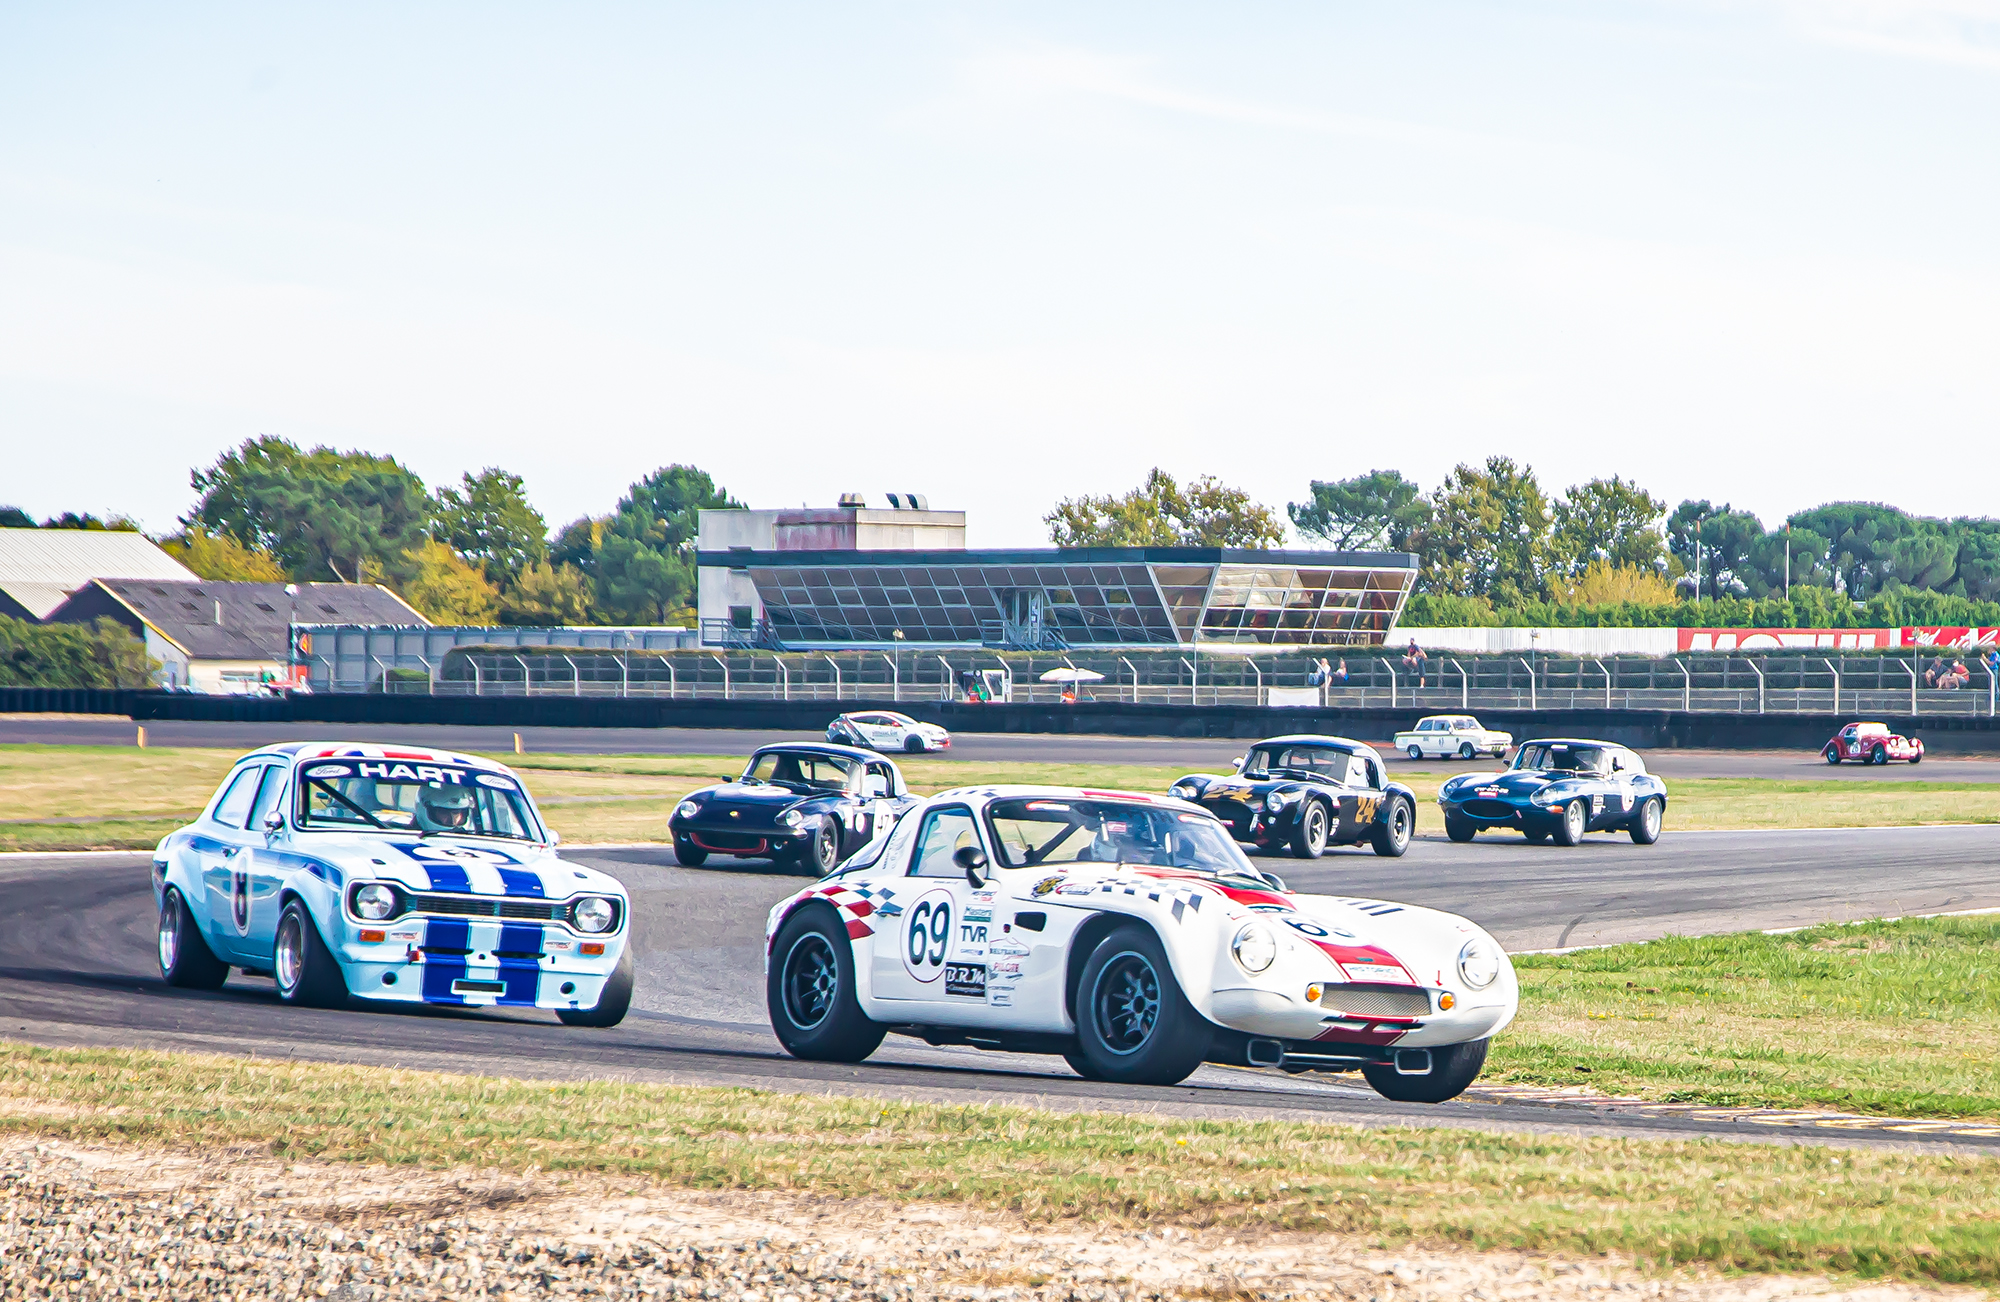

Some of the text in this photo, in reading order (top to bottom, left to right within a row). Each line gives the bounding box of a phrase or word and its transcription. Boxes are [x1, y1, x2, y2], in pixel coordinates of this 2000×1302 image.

[315, 766, 341, 776] Ford
[358, 763, 467, 784] HART
[1355, 794, 1377, 824] 24
[908, 900, 950, 967] 69
[960, 925, 988, 943] TVR
